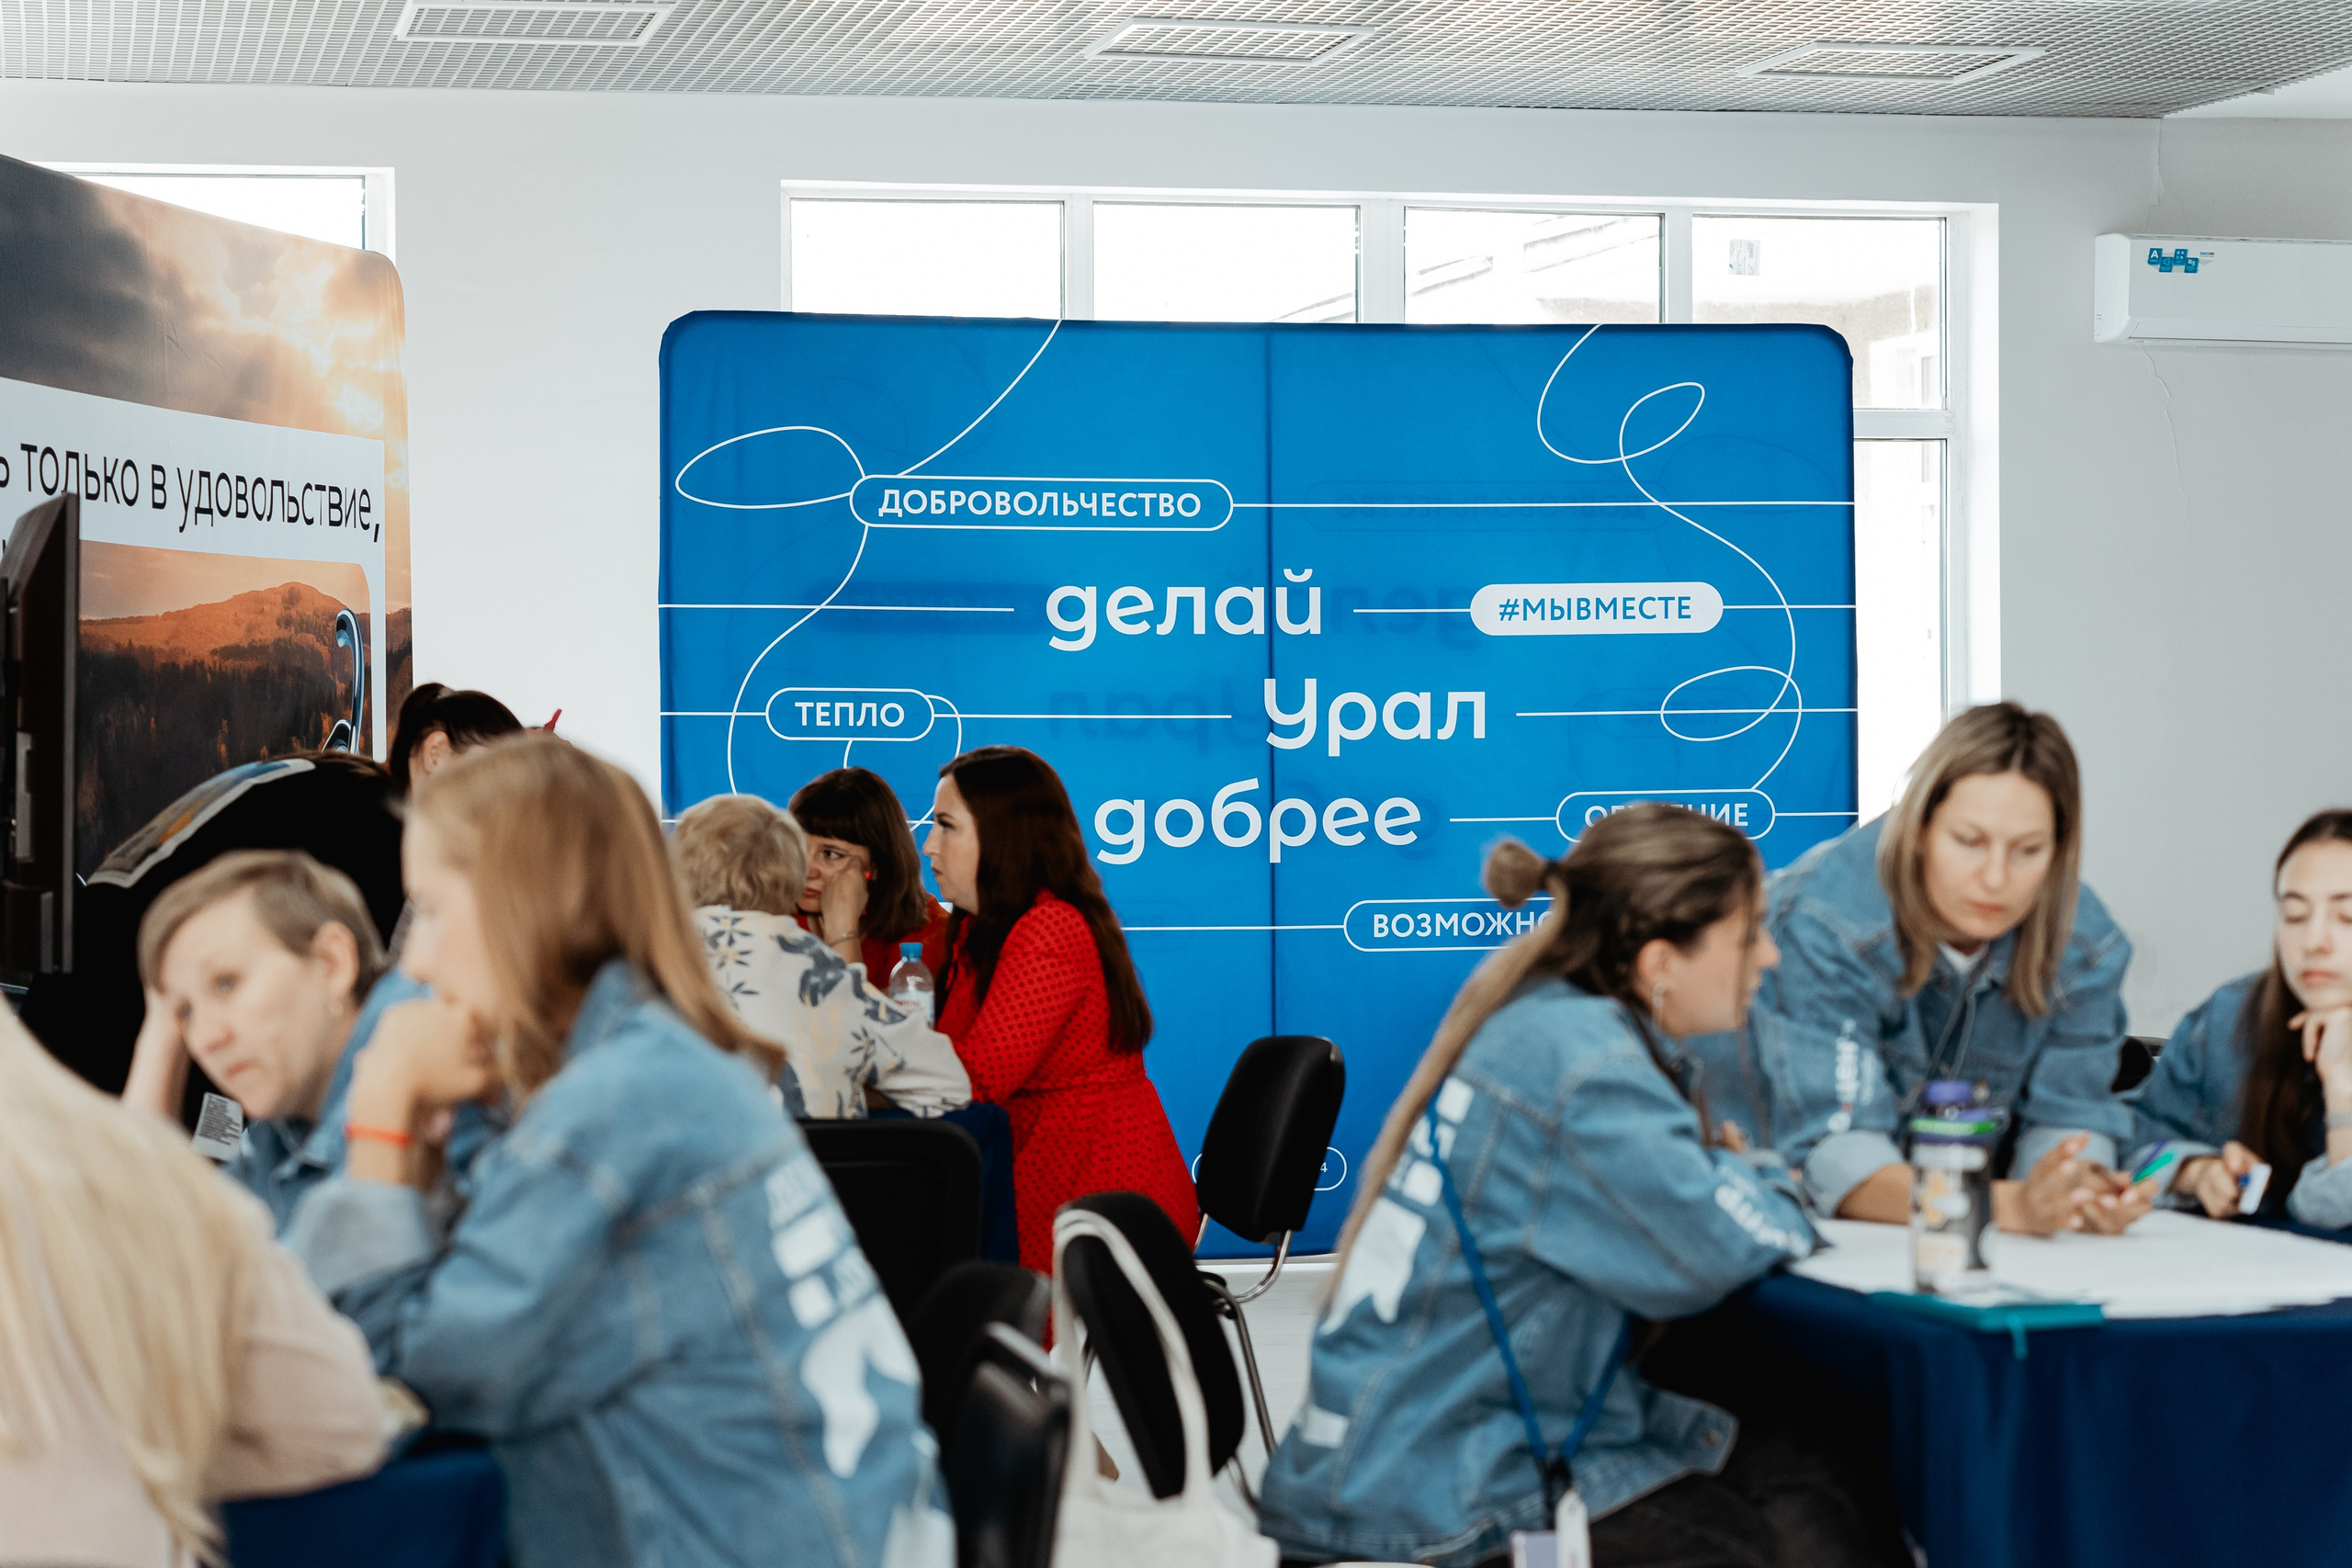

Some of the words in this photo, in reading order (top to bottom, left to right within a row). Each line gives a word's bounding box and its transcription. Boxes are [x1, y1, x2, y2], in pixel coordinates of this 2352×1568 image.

[20, 443, 139, 507] только
[151, 464, 167, 510] в
[176, 467, 380, 543] удовольствие,
[878, 489, 1202, 518] ДОБРОВОЛЬЧЕСТВО
[1046, 568, 1321, 652] делай
[1498, 596, 1691, 622] #МЫВМЕСТЕ
[795, 702, 905, 728] ТЕПЛО
[1263, 678, 1486, 757] Урал
[1093, 777, 1421, 865] добрее
